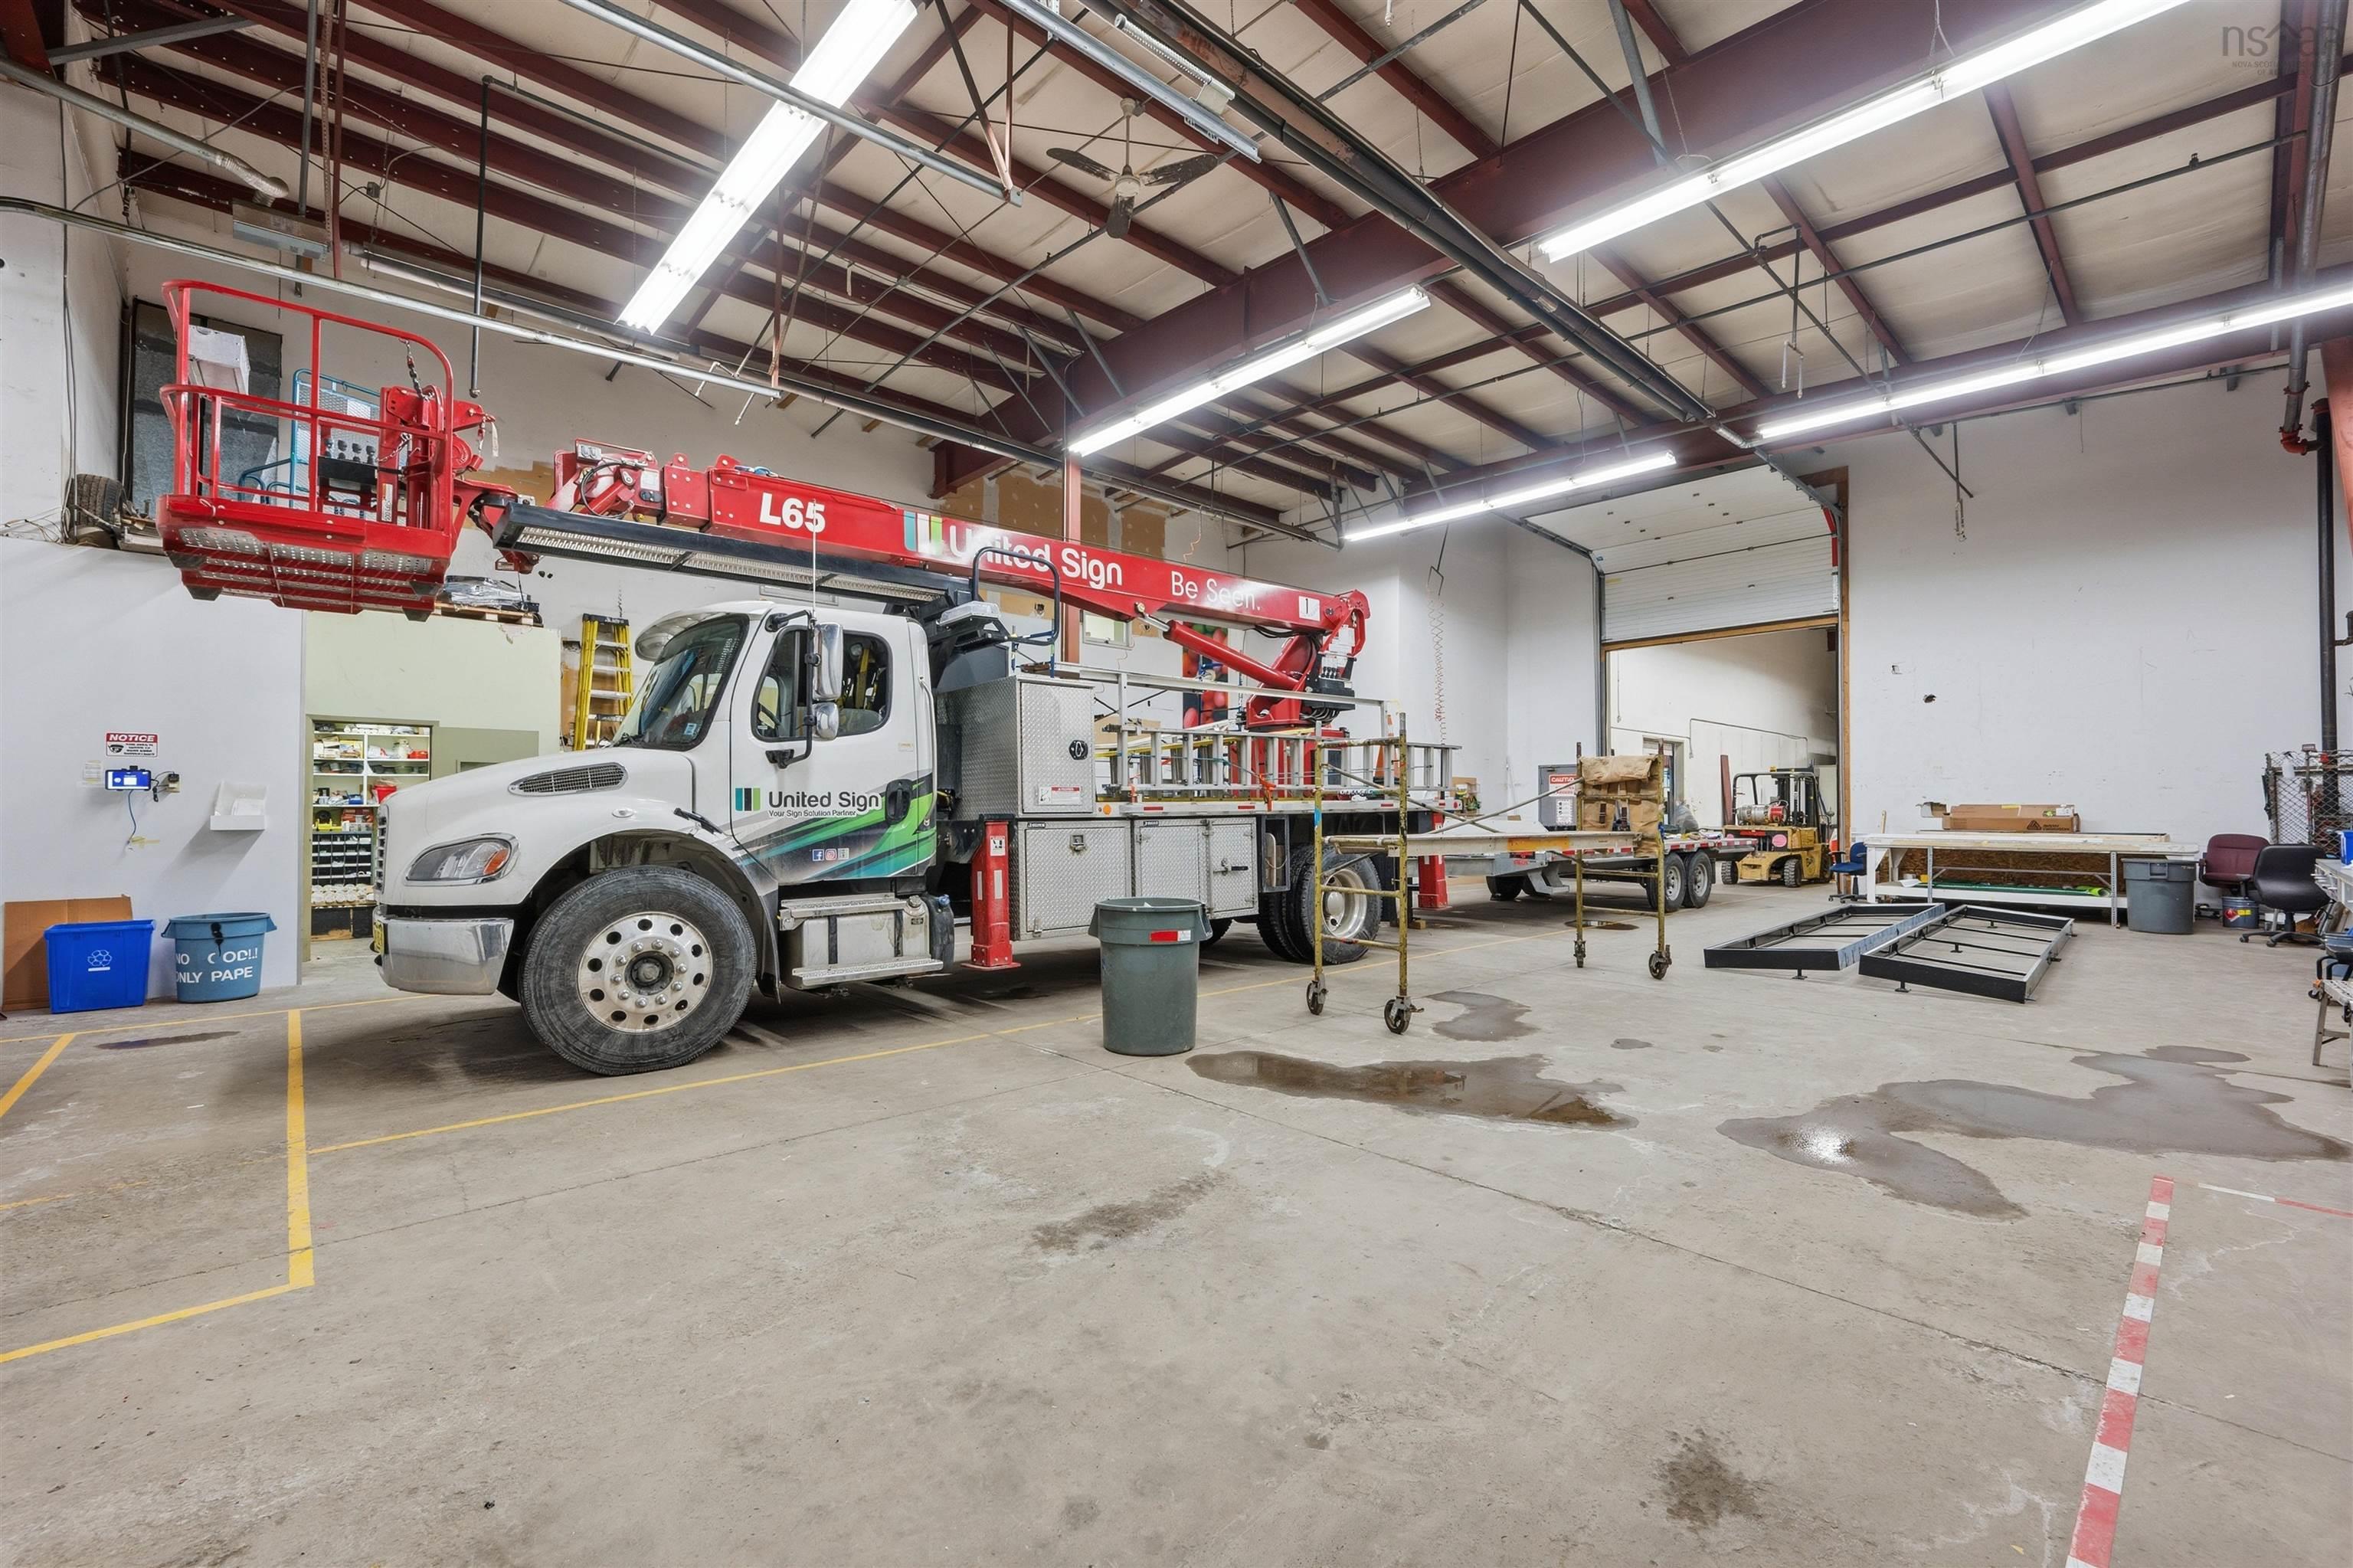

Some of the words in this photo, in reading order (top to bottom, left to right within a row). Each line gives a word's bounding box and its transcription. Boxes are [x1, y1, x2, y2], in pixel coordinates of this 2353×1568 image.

[759, 492, 826, 532] L65
[1061, 548, 1123, 590] Sign
[1171, 571, 1199, 599] Be
[1206, 578, 1261, 611] Seen.
[109, 734, 155, 742] NOTICE
[768, 791, 831, 808] United
[839, 791, 879, 812] Sign
[787, 810, 802, 818] Sign
[176, 953, 190, 965] NO
[211, 966, 254, 982] PAPE
